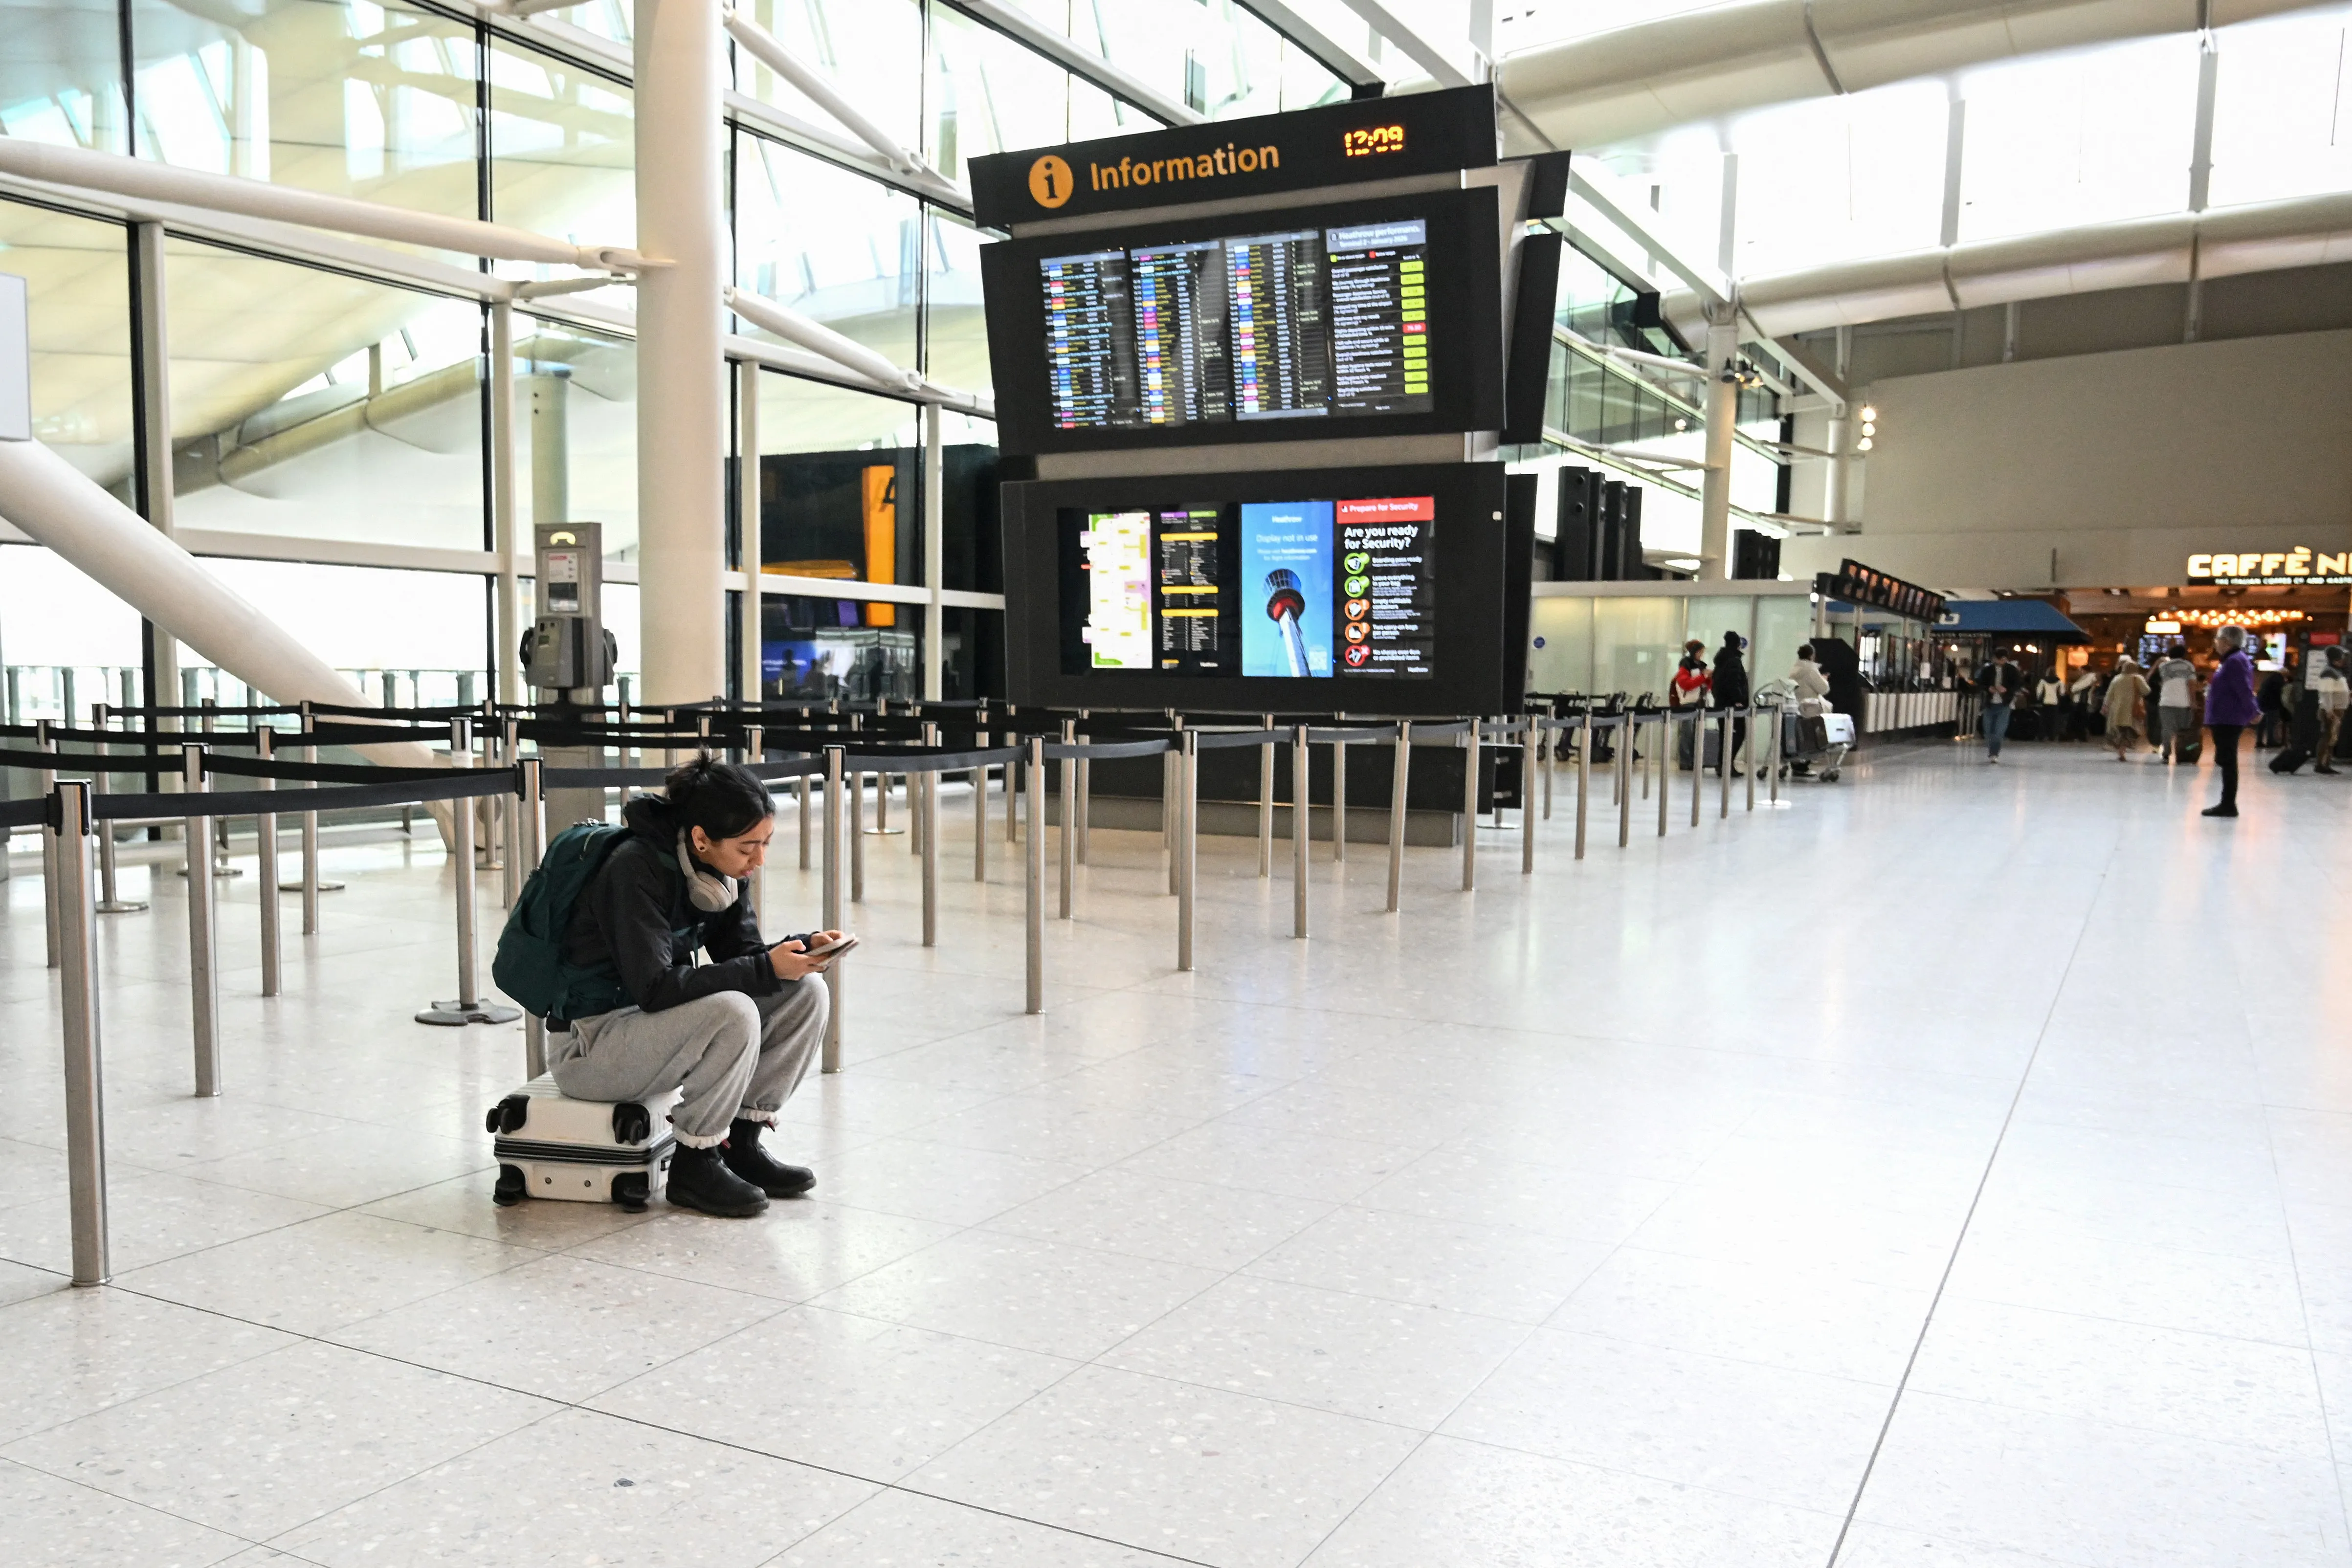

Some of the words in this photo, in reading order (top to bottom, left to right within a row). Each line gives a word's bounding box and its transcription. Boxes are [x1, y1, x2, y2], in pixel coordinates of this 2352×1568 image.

[1344, 126, 1403, 157] 12:09
[1090, 141, 1280, 192] Information
[1349, 504, 1376, 514] Prepare
[1377, 503, 1388, 511] for
[1389, 502, 1419, 513] Security
[1256, 534, 1281, 544] Display
[1283, 534, 1295, 542] not
[1344, 528, 1363, 538] Are
[1365, 528, 1386, 539] you
[1387, 524, 1419, 538] ready
[1344, 537, 1361, 550] for
[1362, 536, 1411, 551] Security?
[2187, 546, 2312, 577] CAFFÈ
[2316, 552, 2352, 576] N
